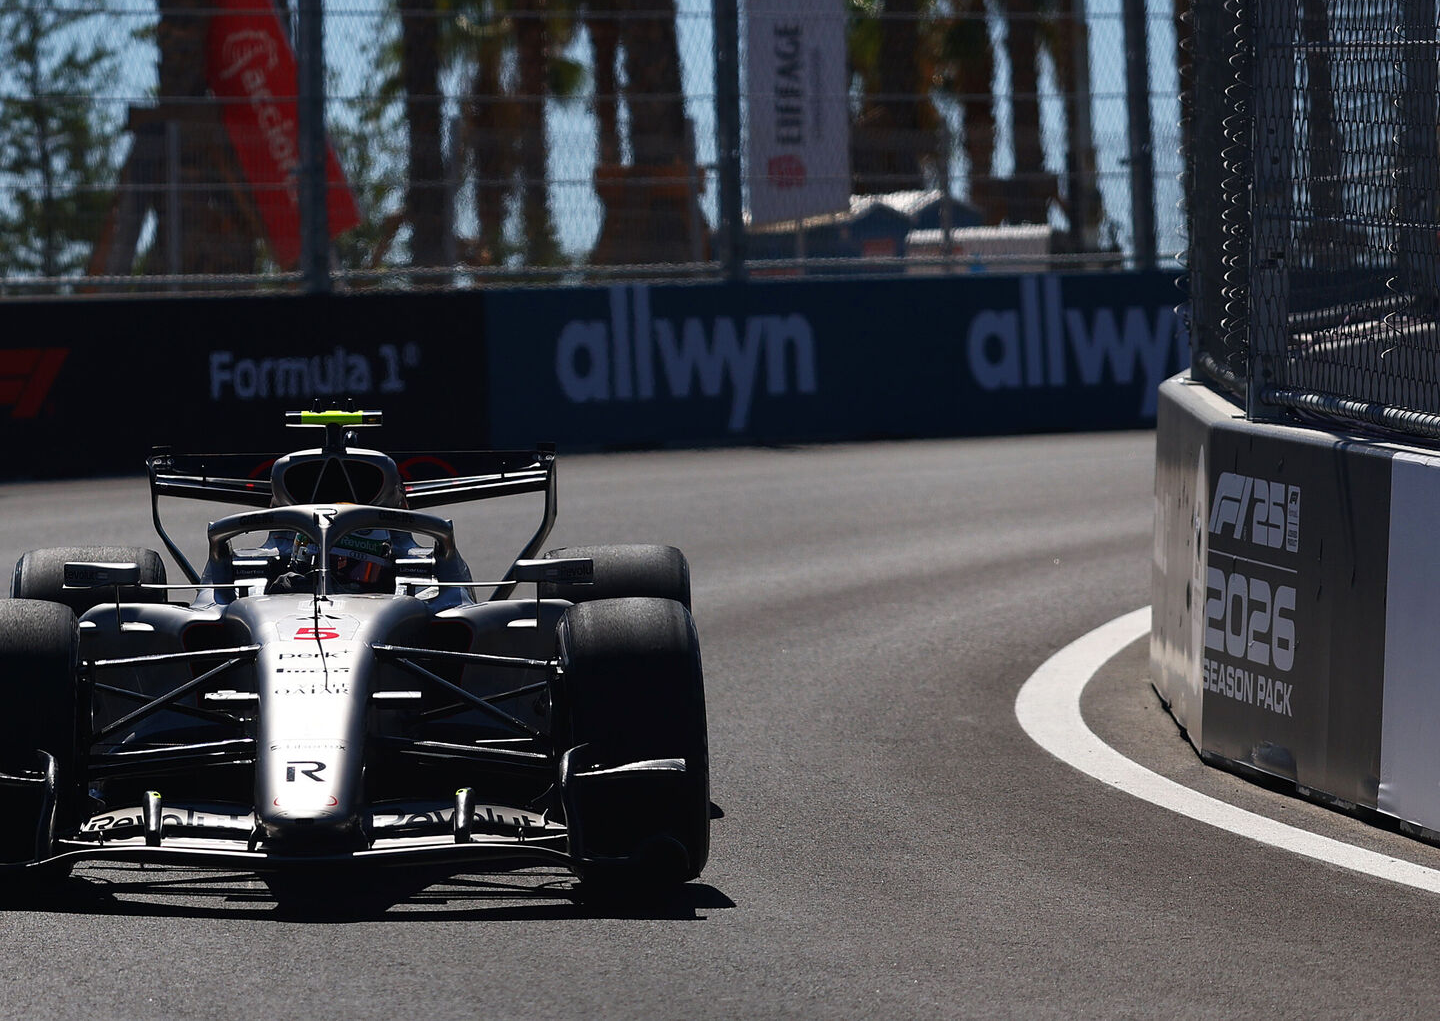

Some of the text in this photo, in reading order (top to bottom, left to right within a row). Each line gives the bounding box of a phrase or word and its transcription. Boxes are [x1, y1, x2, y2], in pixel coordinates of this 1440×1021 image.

[209, 345, 372, 401] Formula
[555, 283, 816, 432] allwyn
[966, 277, 1192, 417] allwy
[293, 627, 340, 640] 5
[1204, 567, 1297, 671] 2026
[1203, 659, 1293, 717] SEASON PACK
